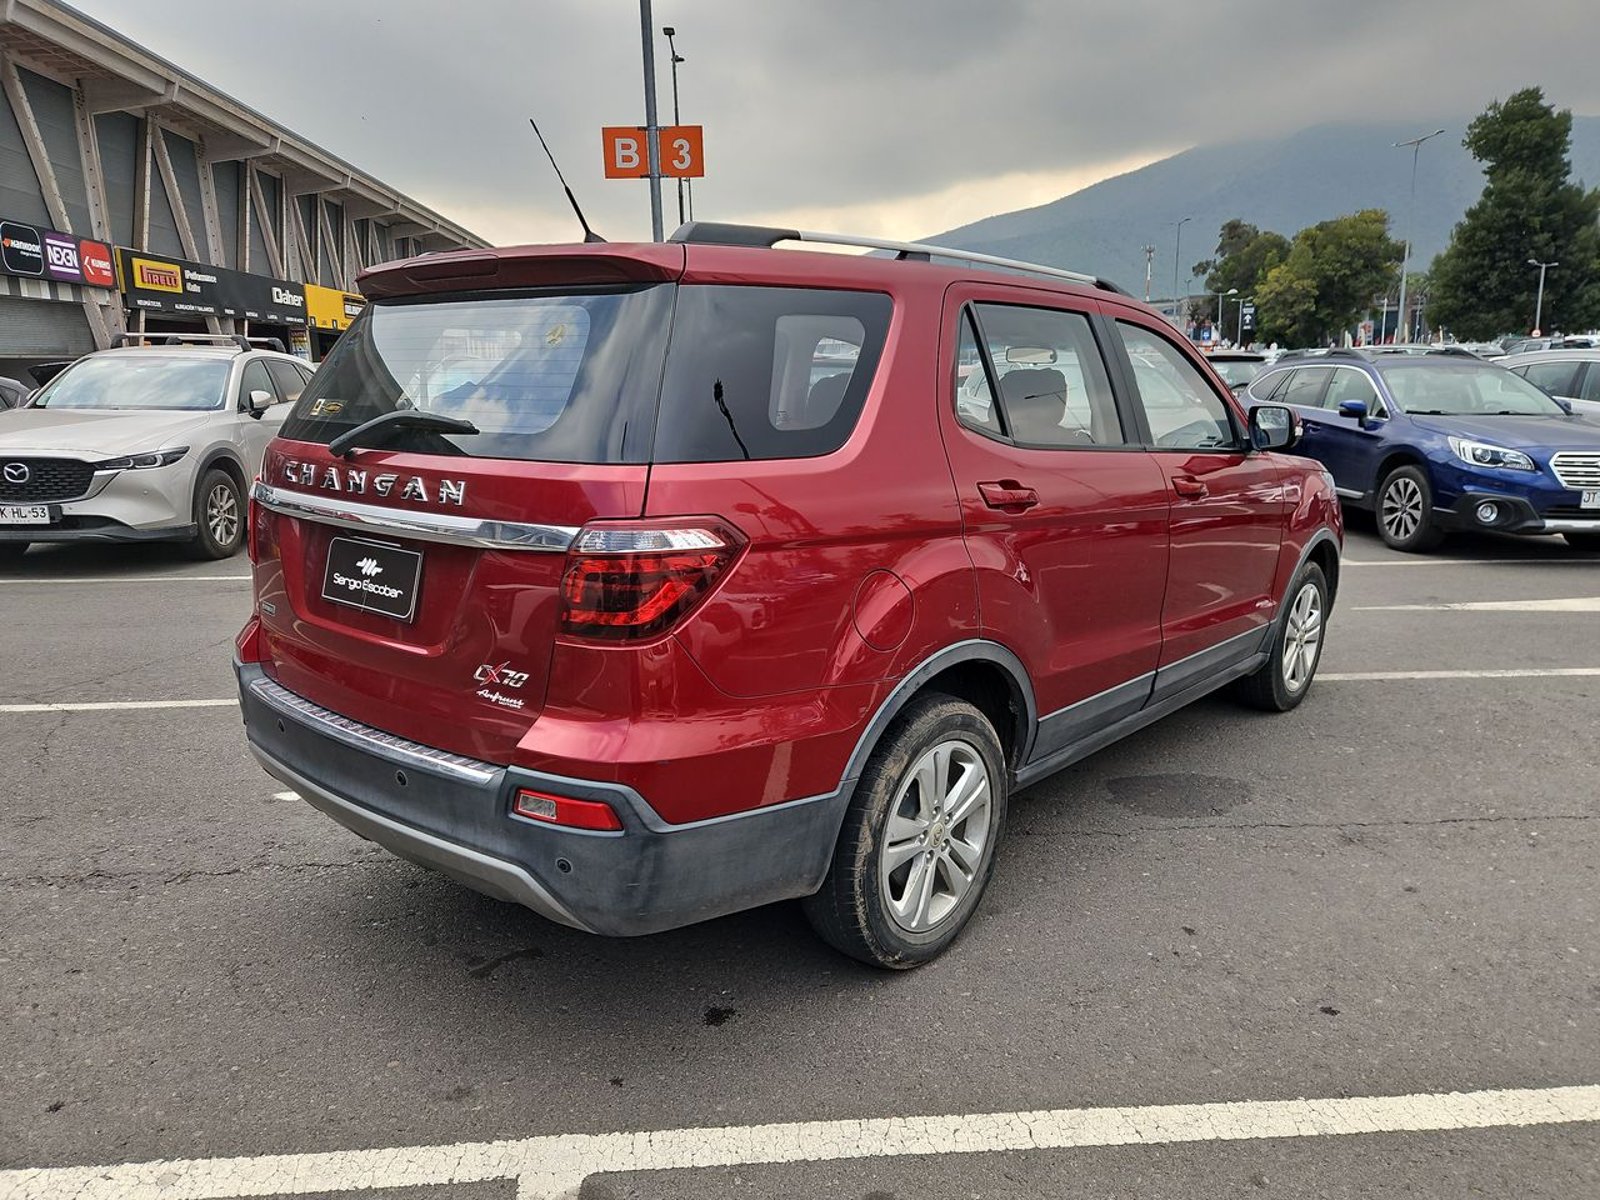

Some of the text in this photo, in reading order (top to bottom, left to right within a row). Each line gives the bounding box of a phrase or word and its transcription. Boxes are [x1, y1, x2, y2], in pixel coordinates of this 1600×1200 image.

[614, 138, 640, 169] B
[672, 138, 692, 170] 3
[272, 287, 303, 307] Daher
[285, 460, 466, 506] CHANGAN
[31, 507, 46, 518] 53
[362, 579, 404, 598] Escobar
